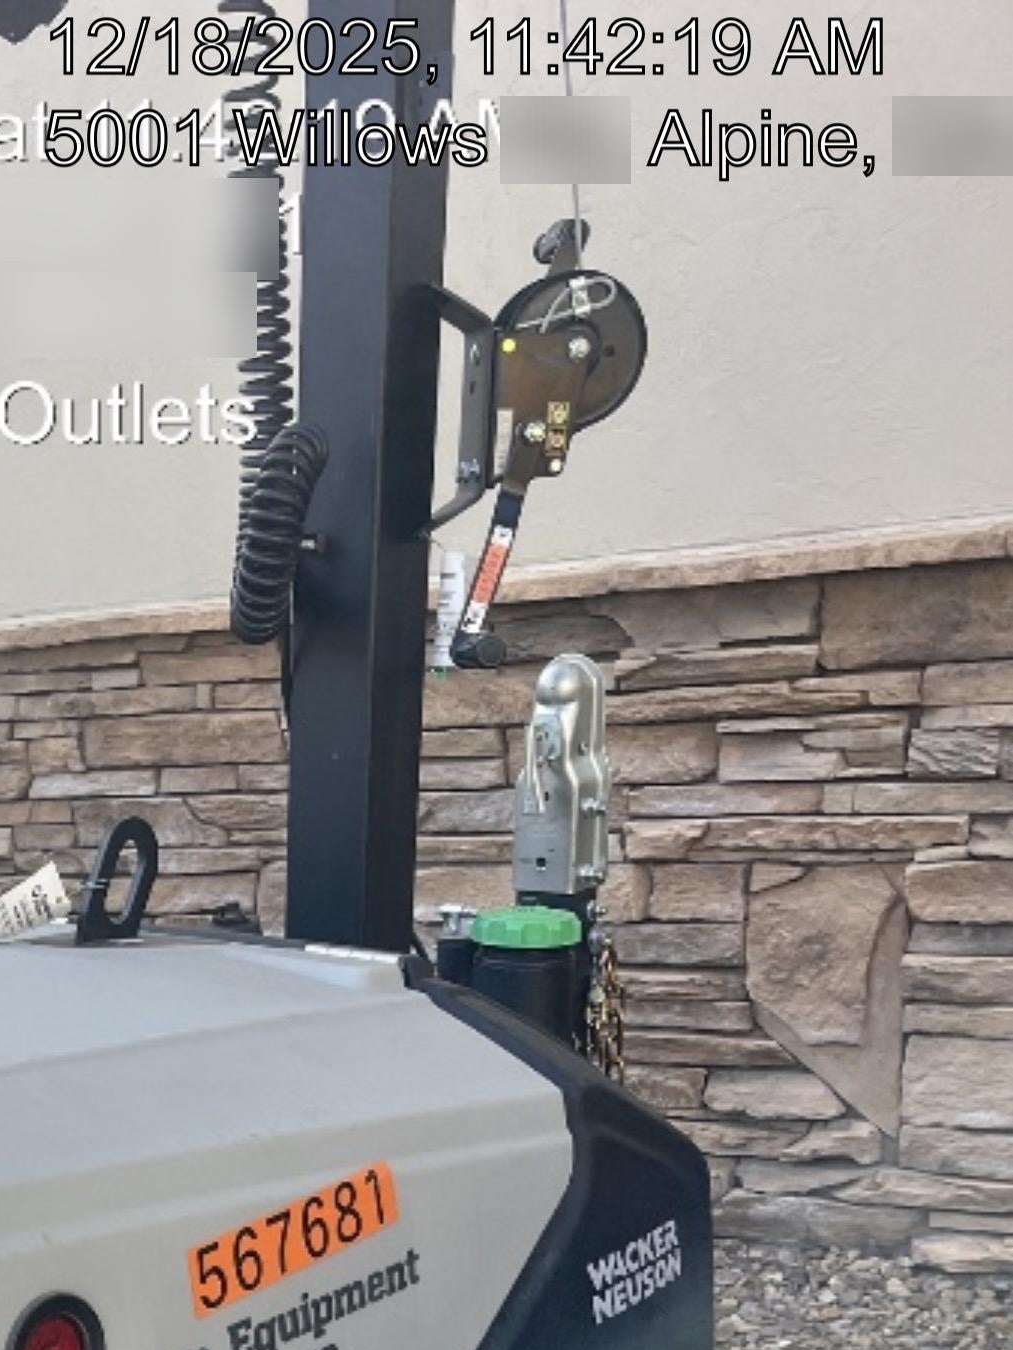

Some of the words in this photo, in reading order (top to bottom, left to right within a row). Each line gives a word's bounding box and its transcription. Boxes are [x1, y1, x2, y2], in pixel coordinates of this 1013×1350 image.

[196, 1169, 384, 1308] 567681
[586, 1220, 678, 1291] WACKER
[592, 1248, 682, 1324] NEUSON
